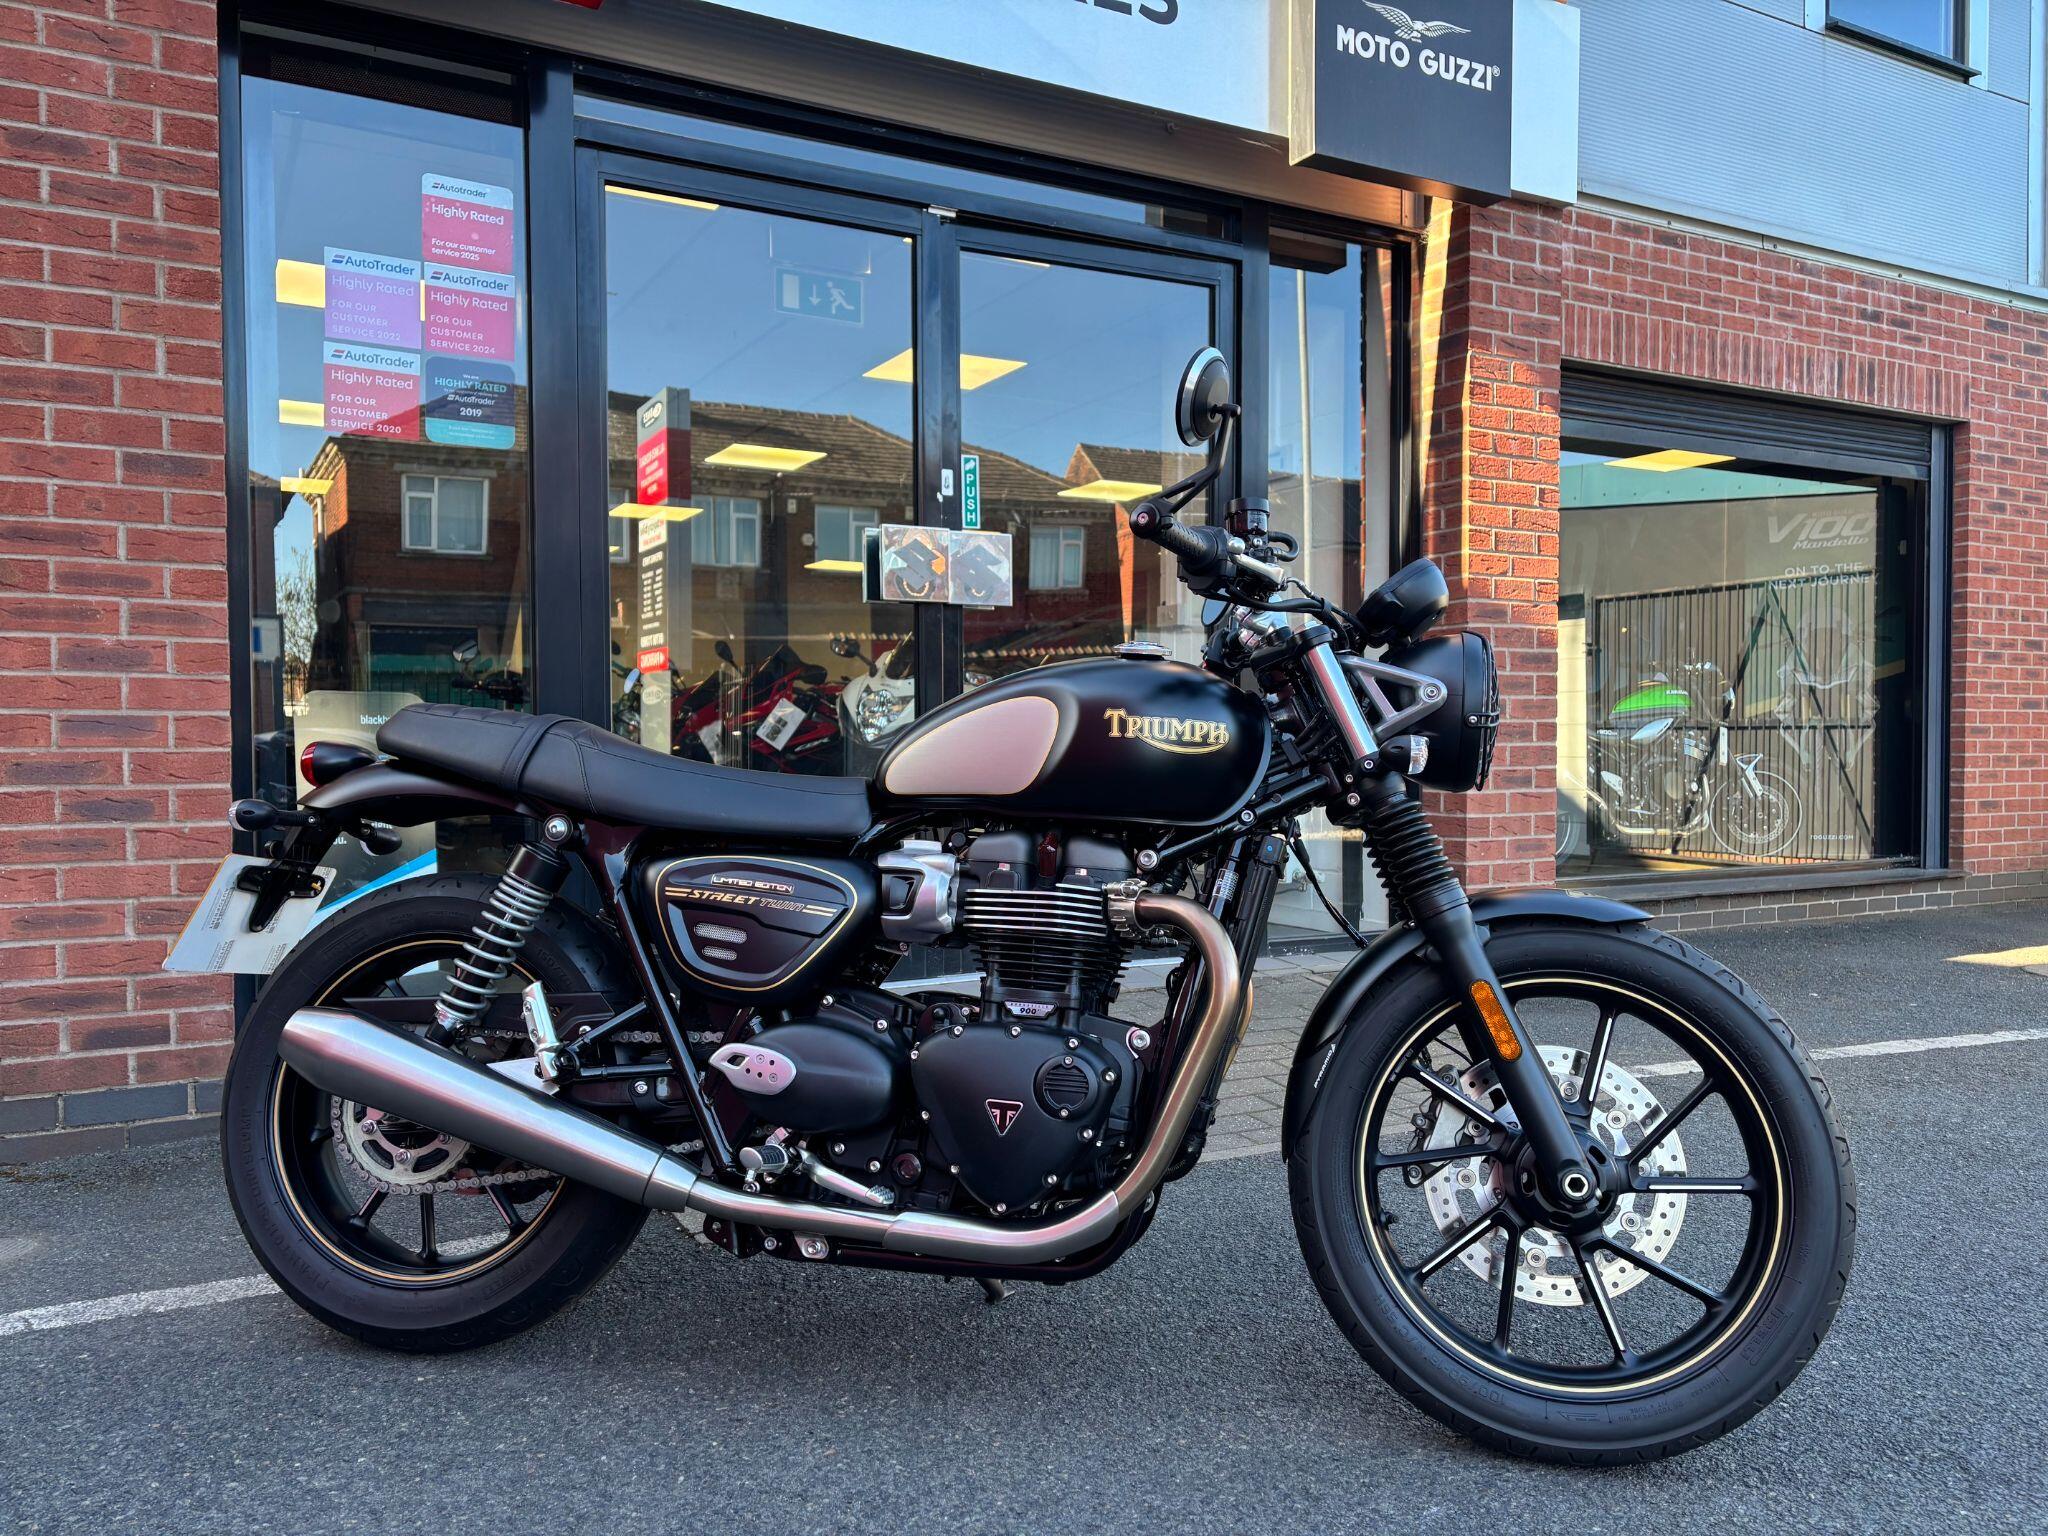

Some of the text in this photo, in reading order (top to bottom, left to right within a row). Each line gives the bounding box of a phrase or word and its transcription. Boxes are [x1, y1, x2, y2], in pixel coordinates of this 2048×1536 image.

[1336, 24, 1411, 68] MOTO
[440, 183, 488, 198] Autotrader
[431, 204, 504, 225] Highly Rated
[431, 237, 445, 246] For
[459, 243, 496, 255] customer
[431, 247, 480, 261] service 2025
[345, 256, 415, 275] AutoTrader
[332, 275, 414, 296] Highly Rated
[443, 273, 509, 291] AutoTrader
[332, 299, 376, 312] FOR OUR
[431, 291, 508, 312] Highly Rated
[332, 312, 388, 327] CUSTOMER
[431, 314, 472, 326] FOR OUR
[332, 324, 374, 337] SERVICE
[431, 327, 484, 341] CUSTOMER
[431, 339, 495, 354] SERVICE 2024
[345, 351, 414, 369] AutoTrader
[331, 370, 413, 389] Highly Rated
[434, 377, 472, 389] HIGHLY
[475, 382, 507, 393] RATED
[331, 394, 376, 406] FOR OUR
[454, 395, 495, 405] AutoTrader
[331, 406, 388, 420] CUSTOMER
[460, 407, 482, 417] 2019
[331, 419, 401, 434] SERVICE 2020
[966, 473, 976, 523] PUSH
[1768, 512, 1877, 543] V100
[1793, 535, 1869, 550] Mandello
[1784, 562, 1863, 577] ON TO THE
[1769, 578, 1806, 590] NEXT
[713, 876, 753, 887] LIMITED
[688, 889, 805, 912] STREET TWIN
